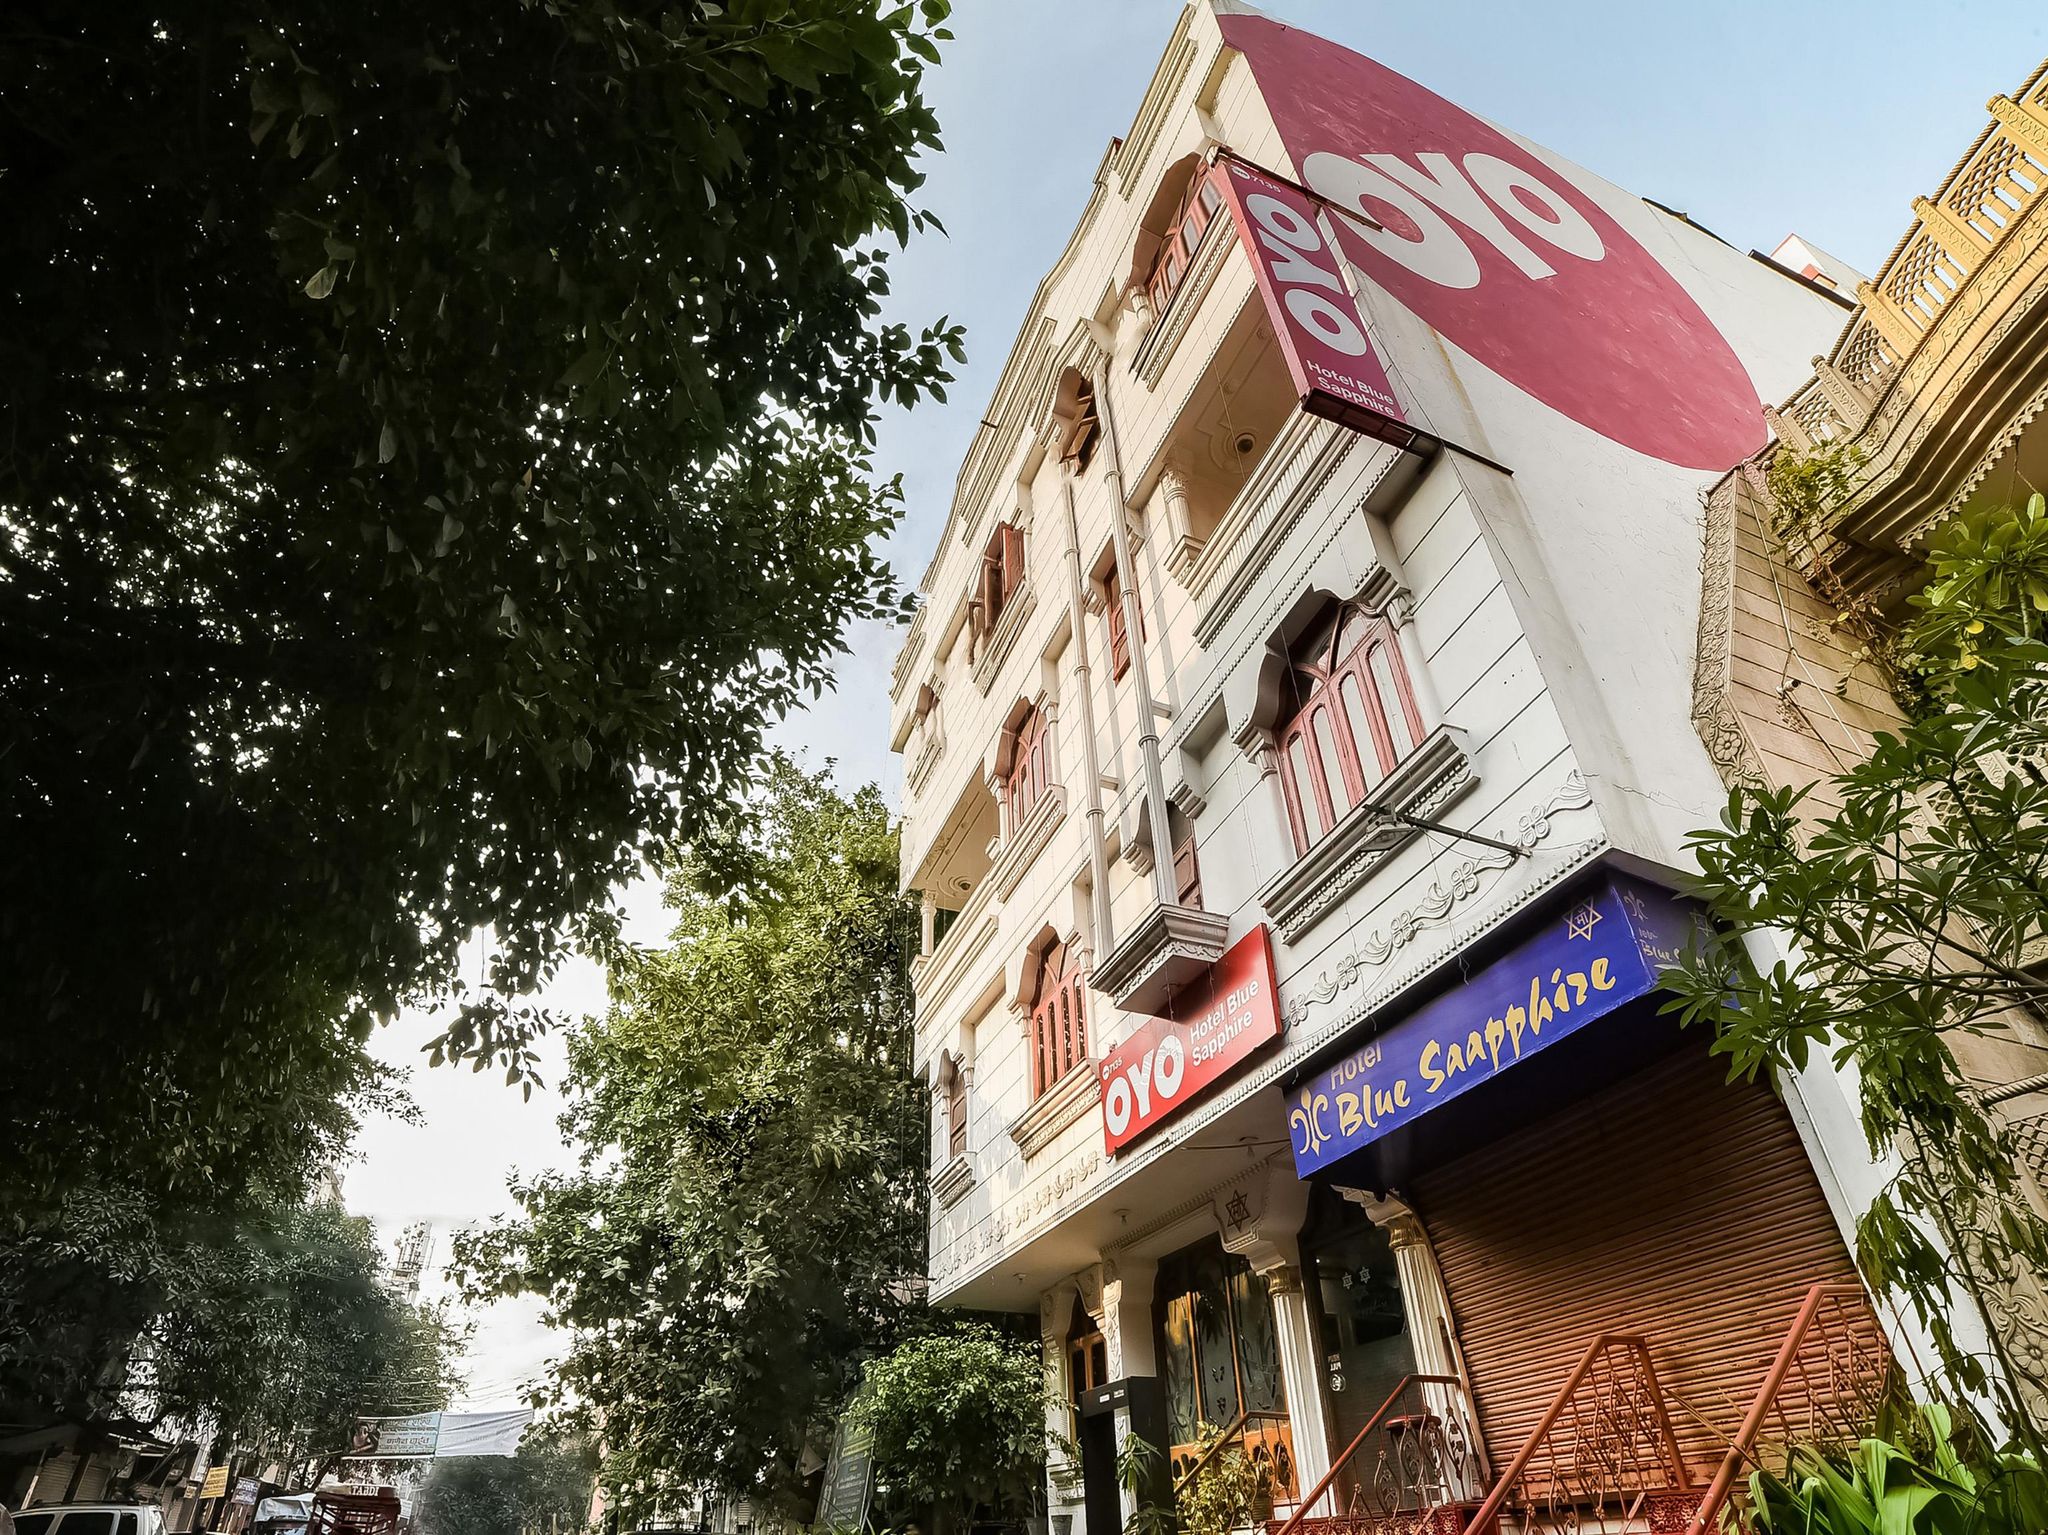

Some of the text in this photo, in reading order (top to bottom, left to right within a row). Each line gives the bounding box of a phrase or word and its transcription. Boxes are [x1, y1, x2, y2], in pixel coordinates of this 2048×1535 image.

[1303, 151, 1605, 289] OYO
[1246, 193, 1367, 357] OYO
[1306, 359, 1394, 405] Hotel Blue
[1317, 377, 1395, 416] Sapphire
[1190, 980, 1259, 1044] Hotel Blue
[1192, 1011, 1254, 1067] Sapphire
[1331, 1041, 1382, 1091] Hotel
[1335, 957, 1617, 1138] Blue Saapphire
[1105, 1034, 1185, 1137] OYO
